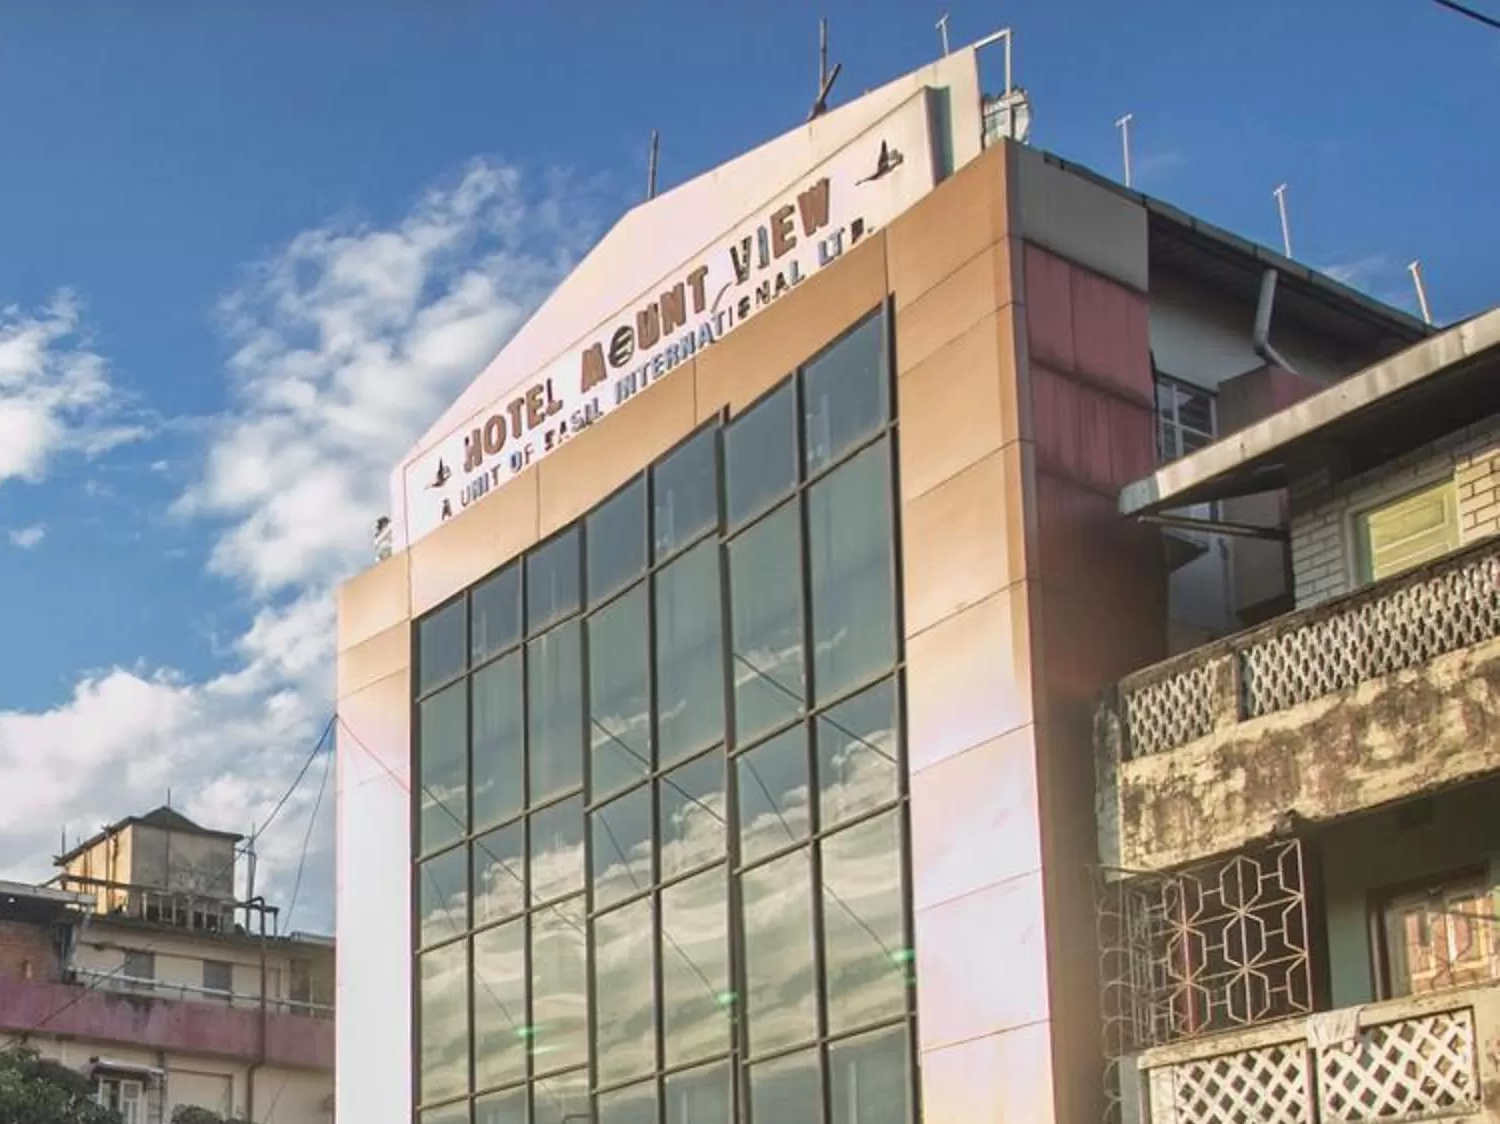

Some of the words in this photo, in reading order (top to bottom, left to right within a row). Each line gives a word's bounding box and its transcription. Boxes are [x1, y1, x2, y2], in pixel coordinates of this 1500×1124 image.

[441, 498, 453, 521] A
[460, 464, 502, 507] UNIT
[510, 443, 535, 474] OF
[614, 260, 806, 405] INTERNATIONAL
[463, 377, 564, 474] HOTEL
[580, 264, 709, 394] MOUNT
[729, 177, 831, 286] VIEW
